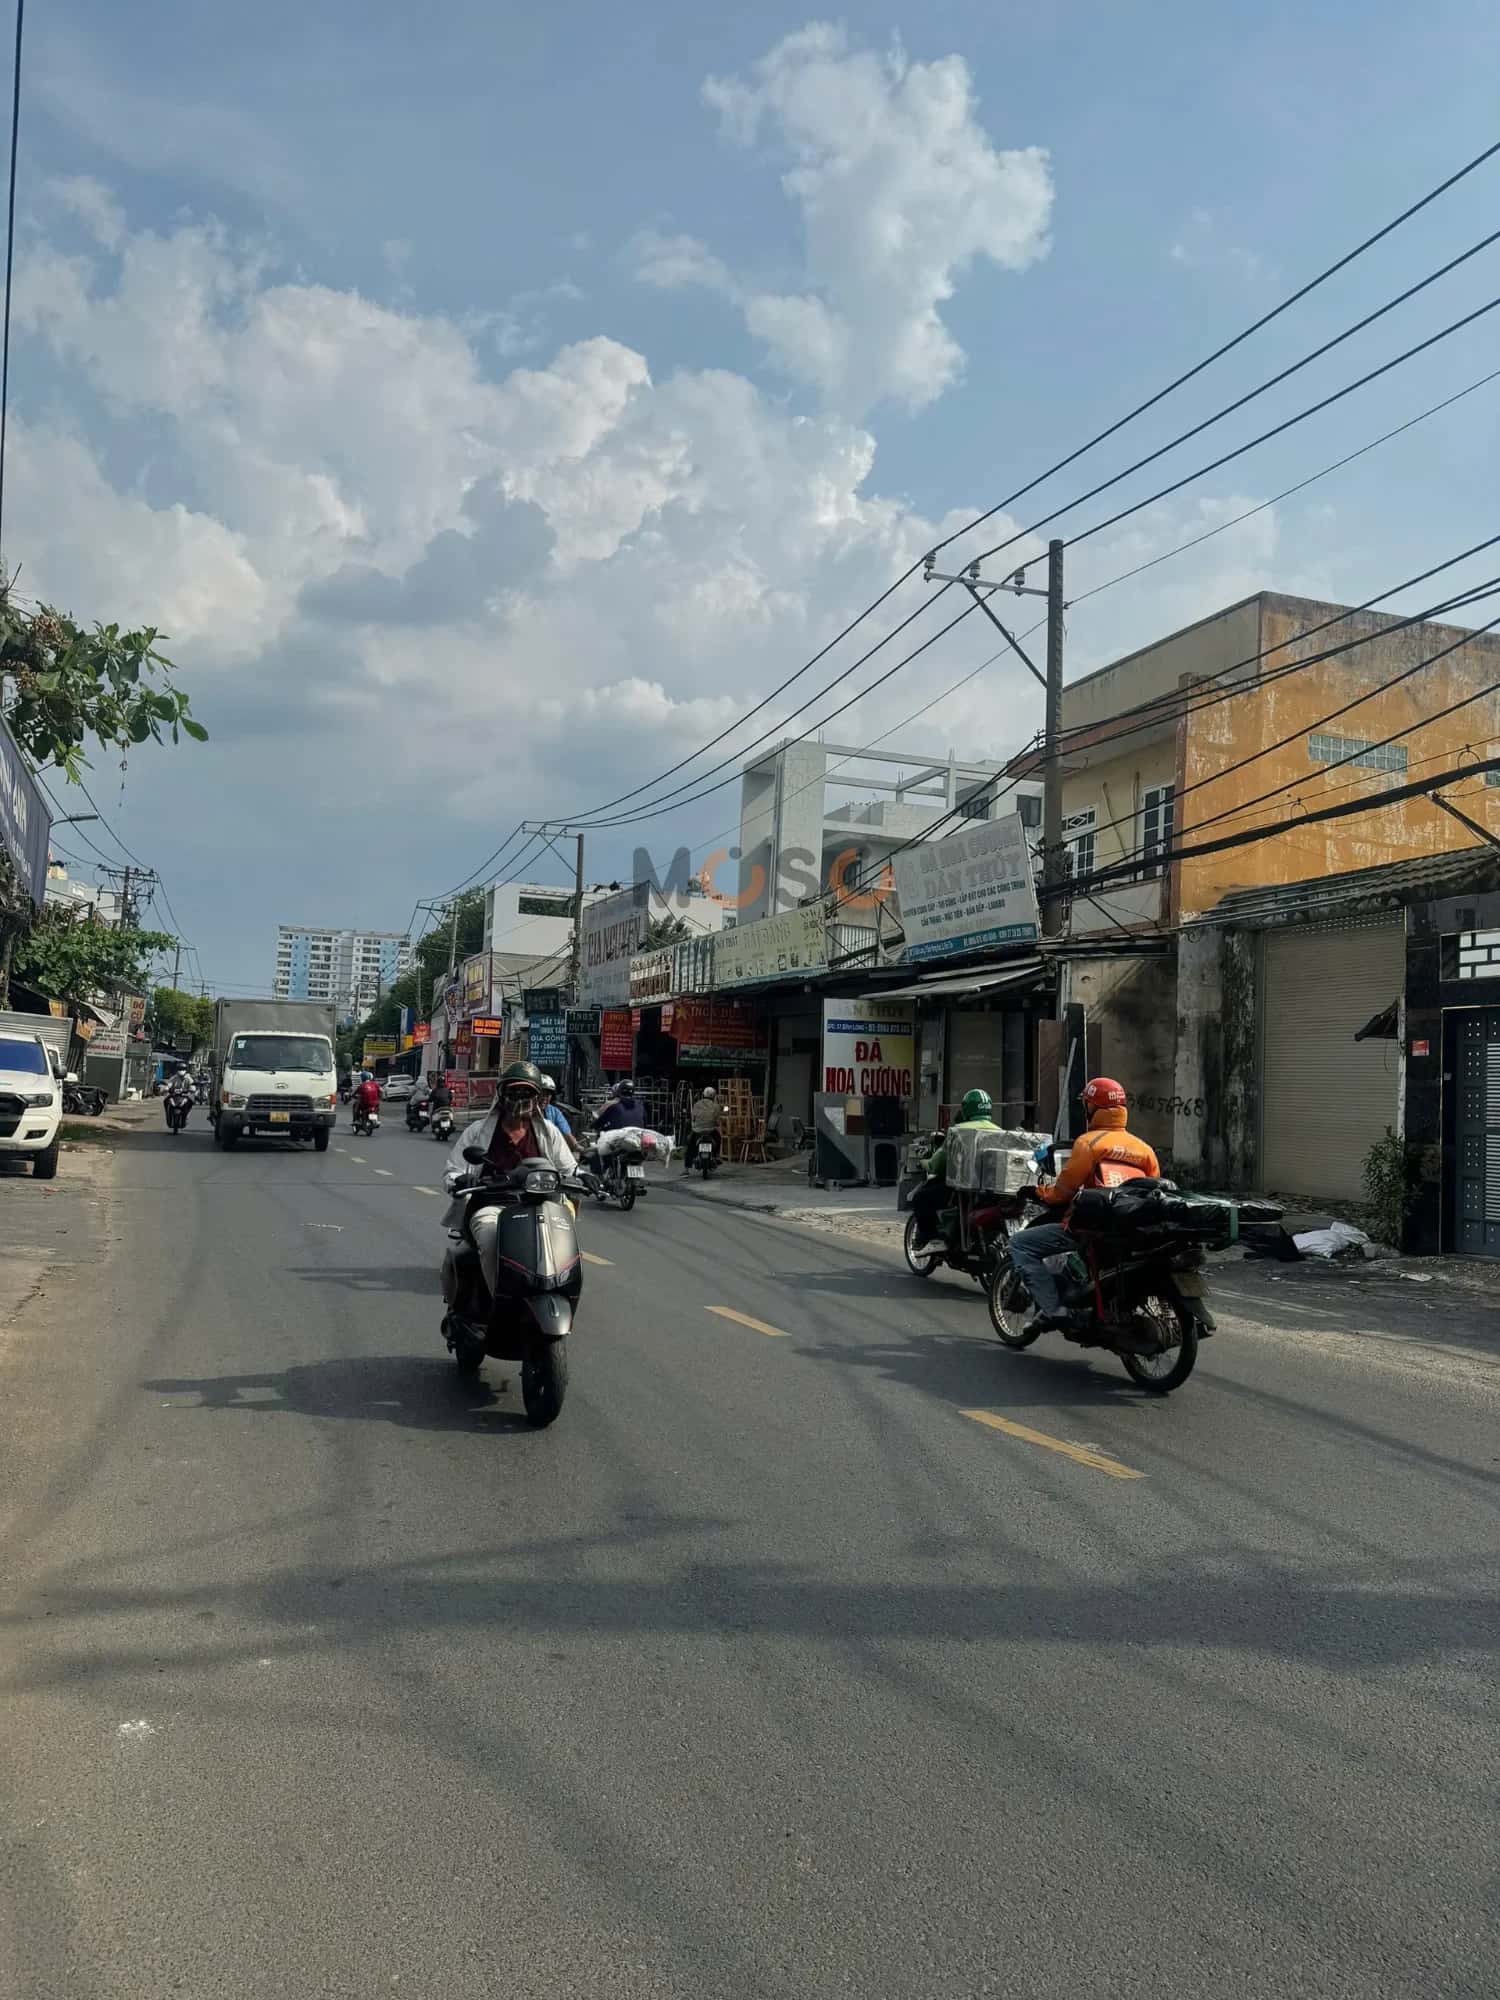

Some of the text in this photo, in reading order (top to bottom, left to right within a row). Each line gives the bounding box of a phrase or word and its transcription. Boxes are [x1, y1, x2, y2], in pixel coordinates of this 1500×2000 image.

[855, 1036, 882, 1063] ĐÁ
[825, 1065, 913, 1097] HOA CƯƠNG
